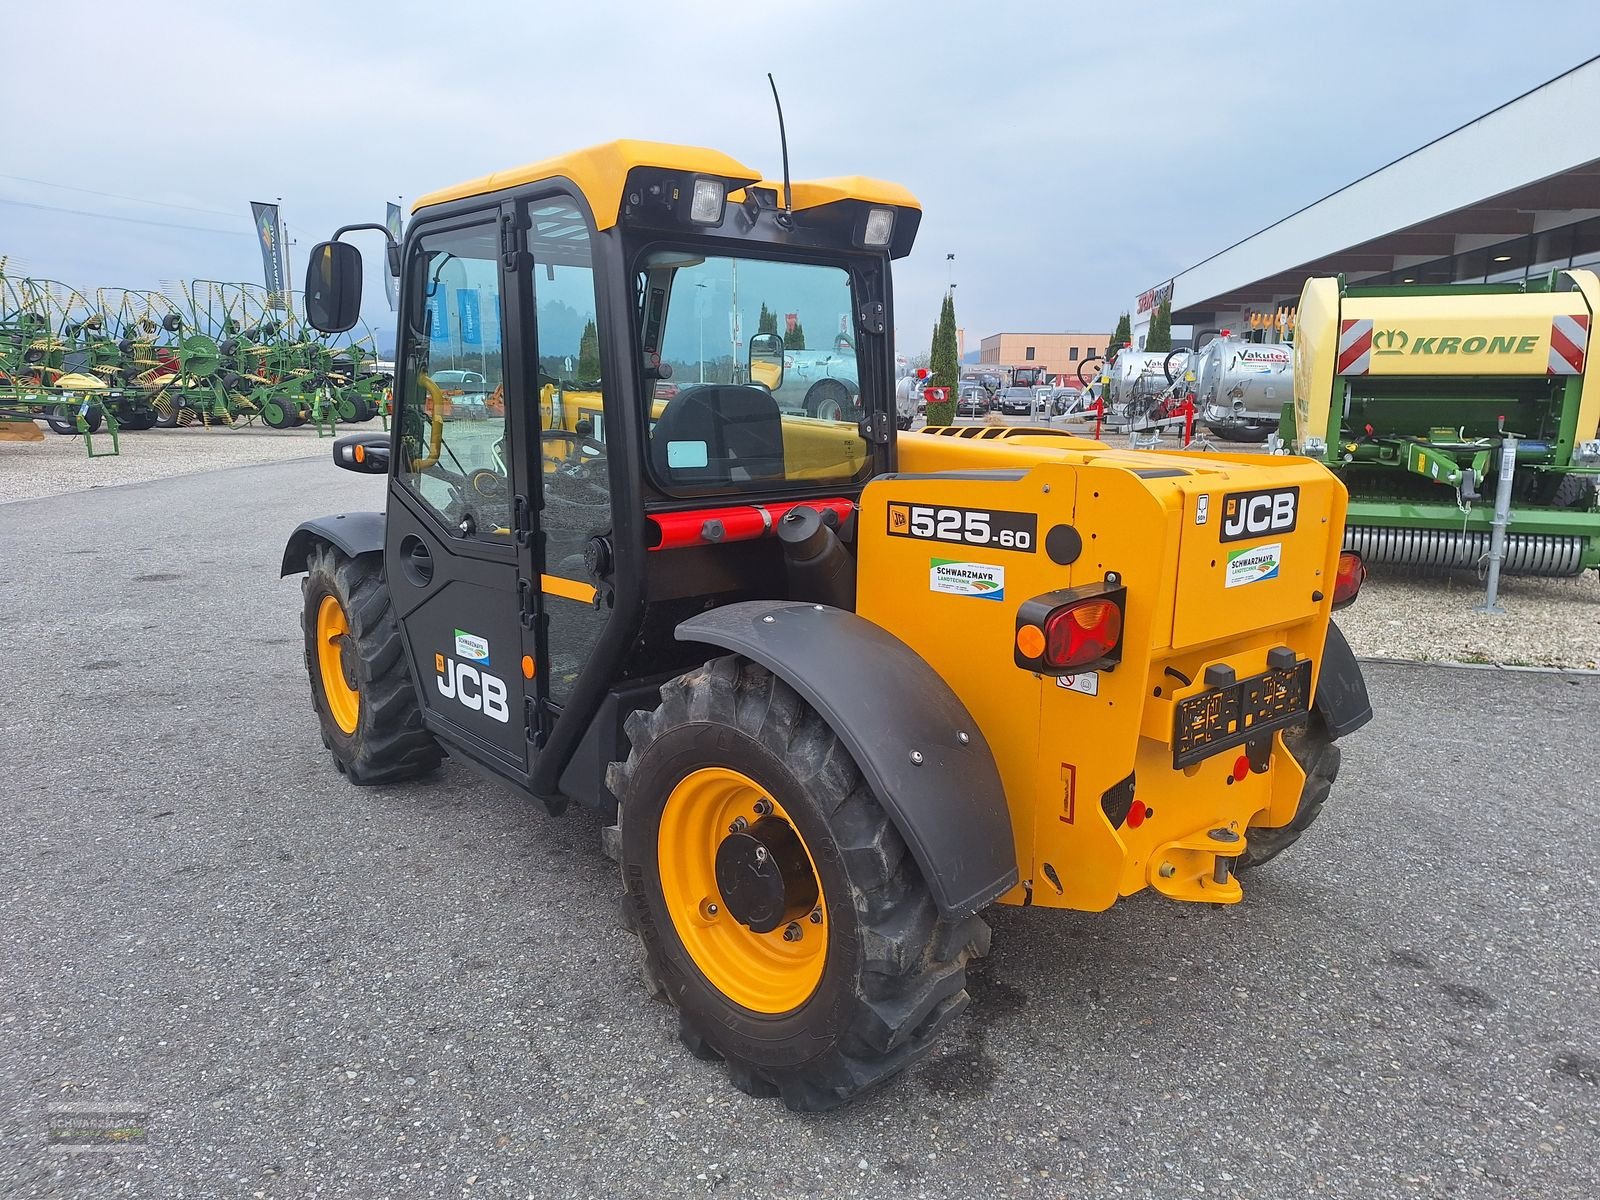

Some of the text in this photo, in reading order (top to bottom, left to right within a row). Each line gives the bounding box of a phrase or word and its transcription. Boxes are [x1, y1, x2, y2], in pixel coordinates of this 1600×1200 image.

[1410, 335, 1540, 355] KRONE
[1237, 349, 1289, 361] Vakutec
[1144, 359, 1182, 368] Vaktec
[1225, 492, 1295, 536] JCB
[1231, 554, 1274, 569] SCHWARZMAYR
[936, 566, 994, 581] SCHWARZMAYR
[436, 658, 509, 724] JCB
